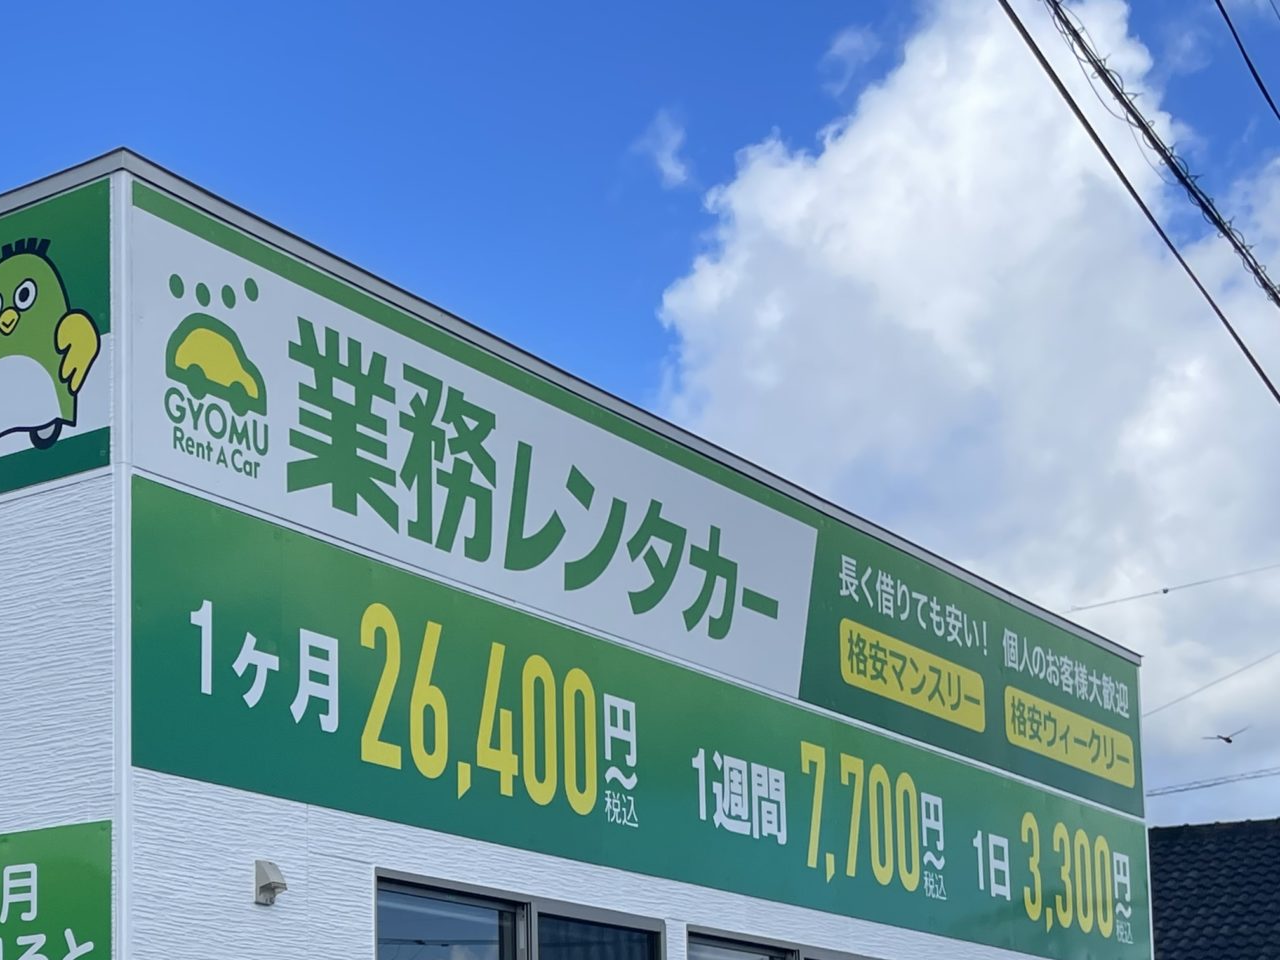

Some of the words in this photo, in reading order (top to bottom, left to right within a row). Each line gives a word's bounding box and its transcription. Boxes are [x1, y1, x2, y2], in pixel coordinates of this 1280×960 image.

[163, 387, 268, 456] GYOMU
[173, 426, 213, 462] Rent
[216, 446, 228, 468] A
[231, 448, 260, 479] Car
[286, 315, 779, 640] 業務レンタカー
[838, 554, 988, 656] 長く借りても安い！
[1002, 628, 1130, 719] 個人のお客様大歓迎
[846, 630, 981, 711] 格安マンスリー
[1011, 696, 1130, 771] 格安ウィークリー
[604, 790, 639, 829] 税込
[691, 748, 788, 846] 1週間
[923, 870, 947, 900] 税込
[972, 830, 1011, 901] 1日
